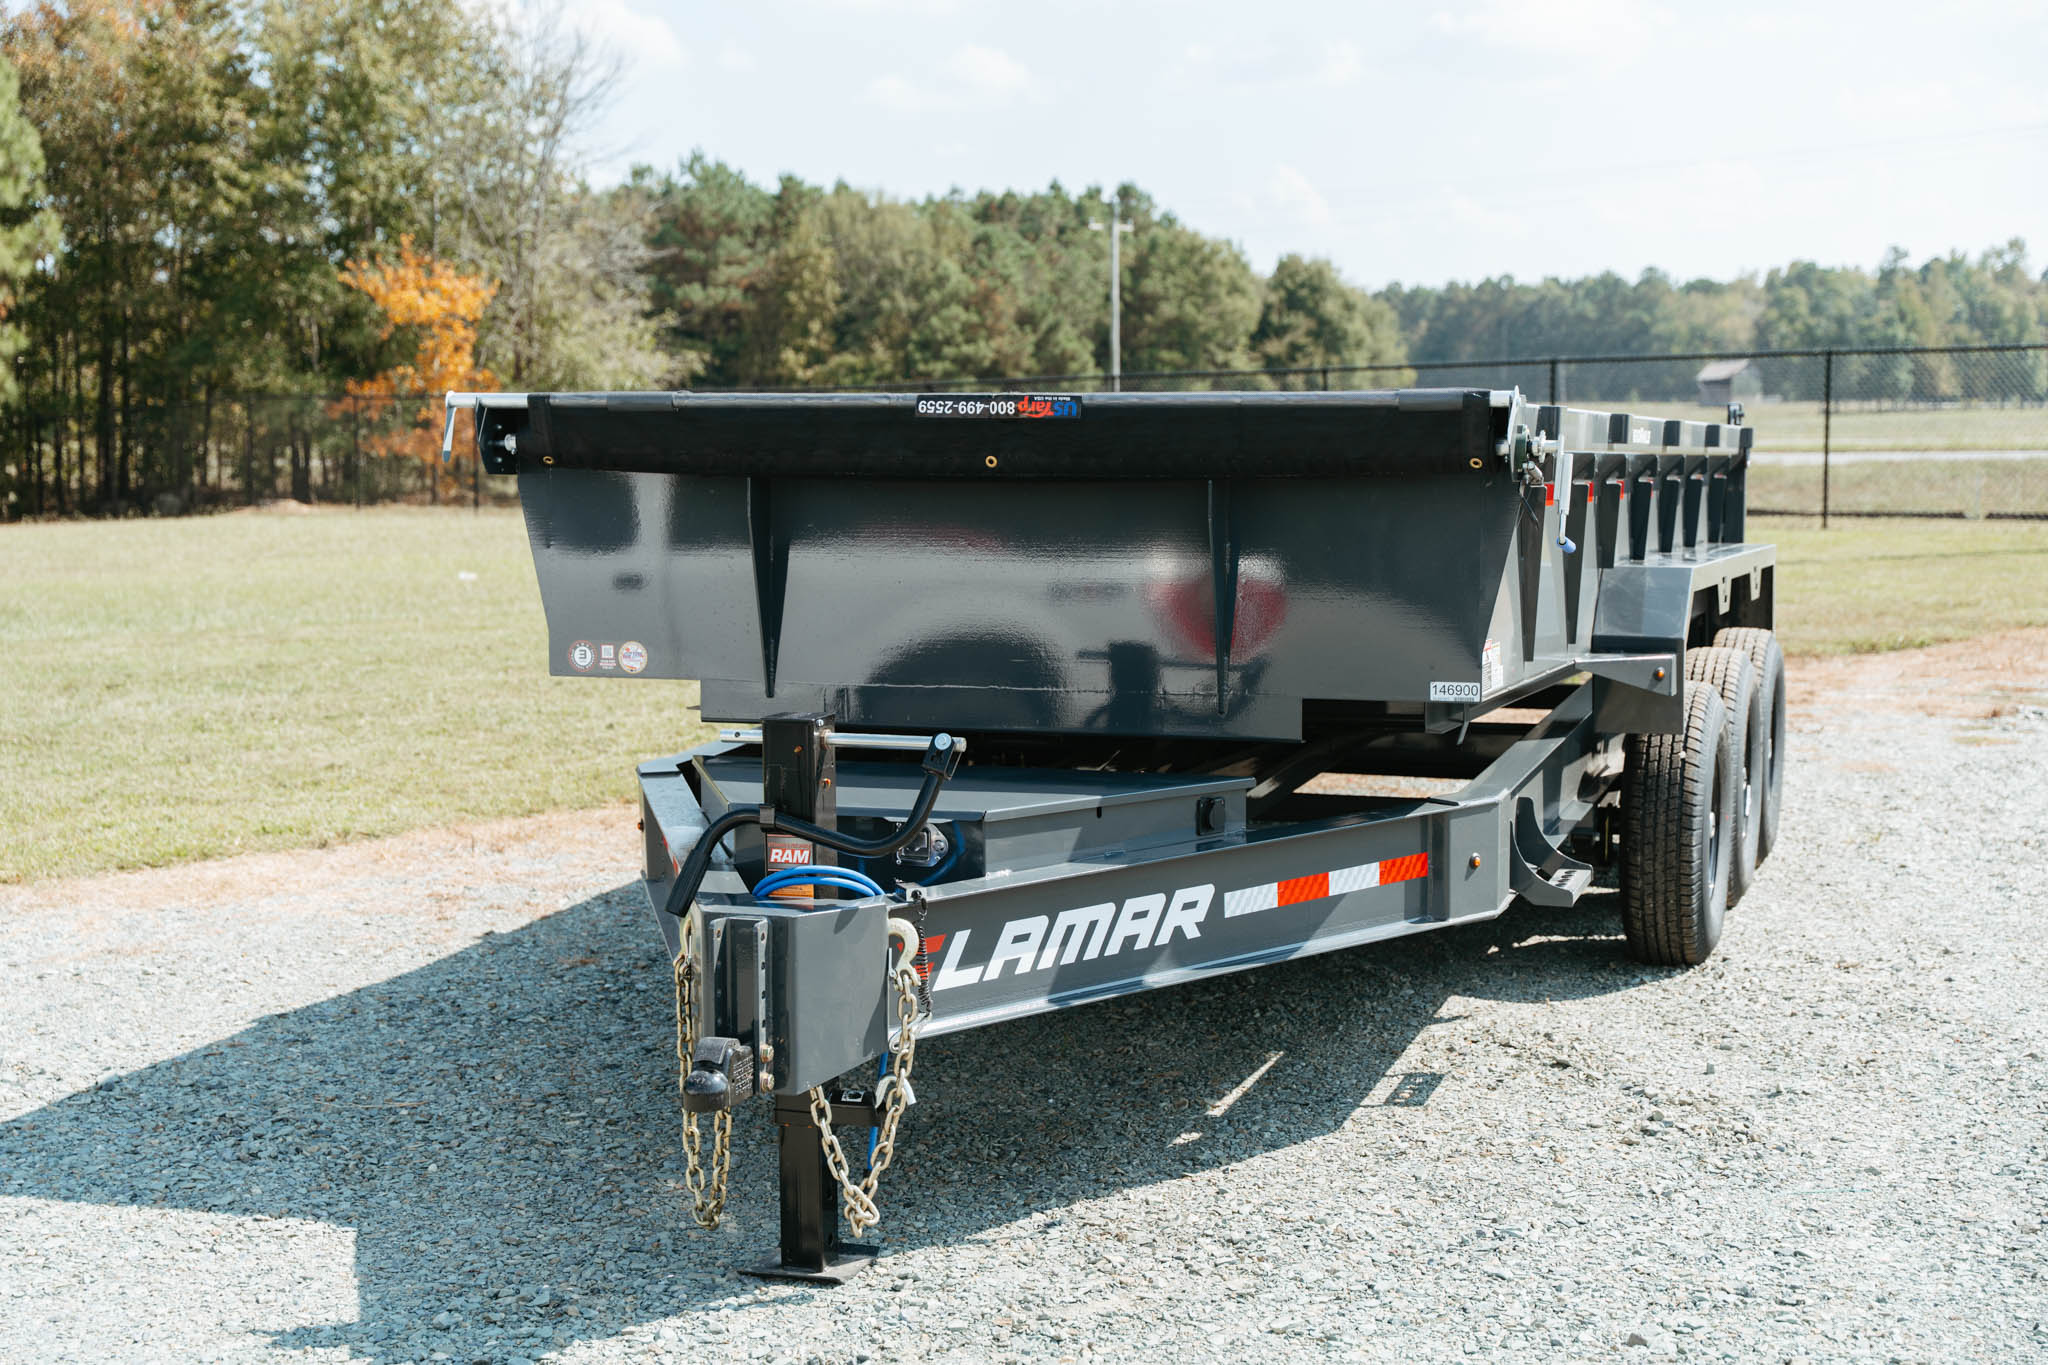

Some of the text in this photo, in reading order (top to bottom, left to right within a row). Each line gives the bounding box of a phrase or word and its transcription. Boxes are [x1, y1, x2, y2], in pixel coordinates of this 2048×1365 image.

[918, 400, 1016, 414] 800-499-2559
[1432, 684, 1479, 697] 146900
[770, 848, 810, 865] RAM
[932, 883, 1216, 993] LAMAR
